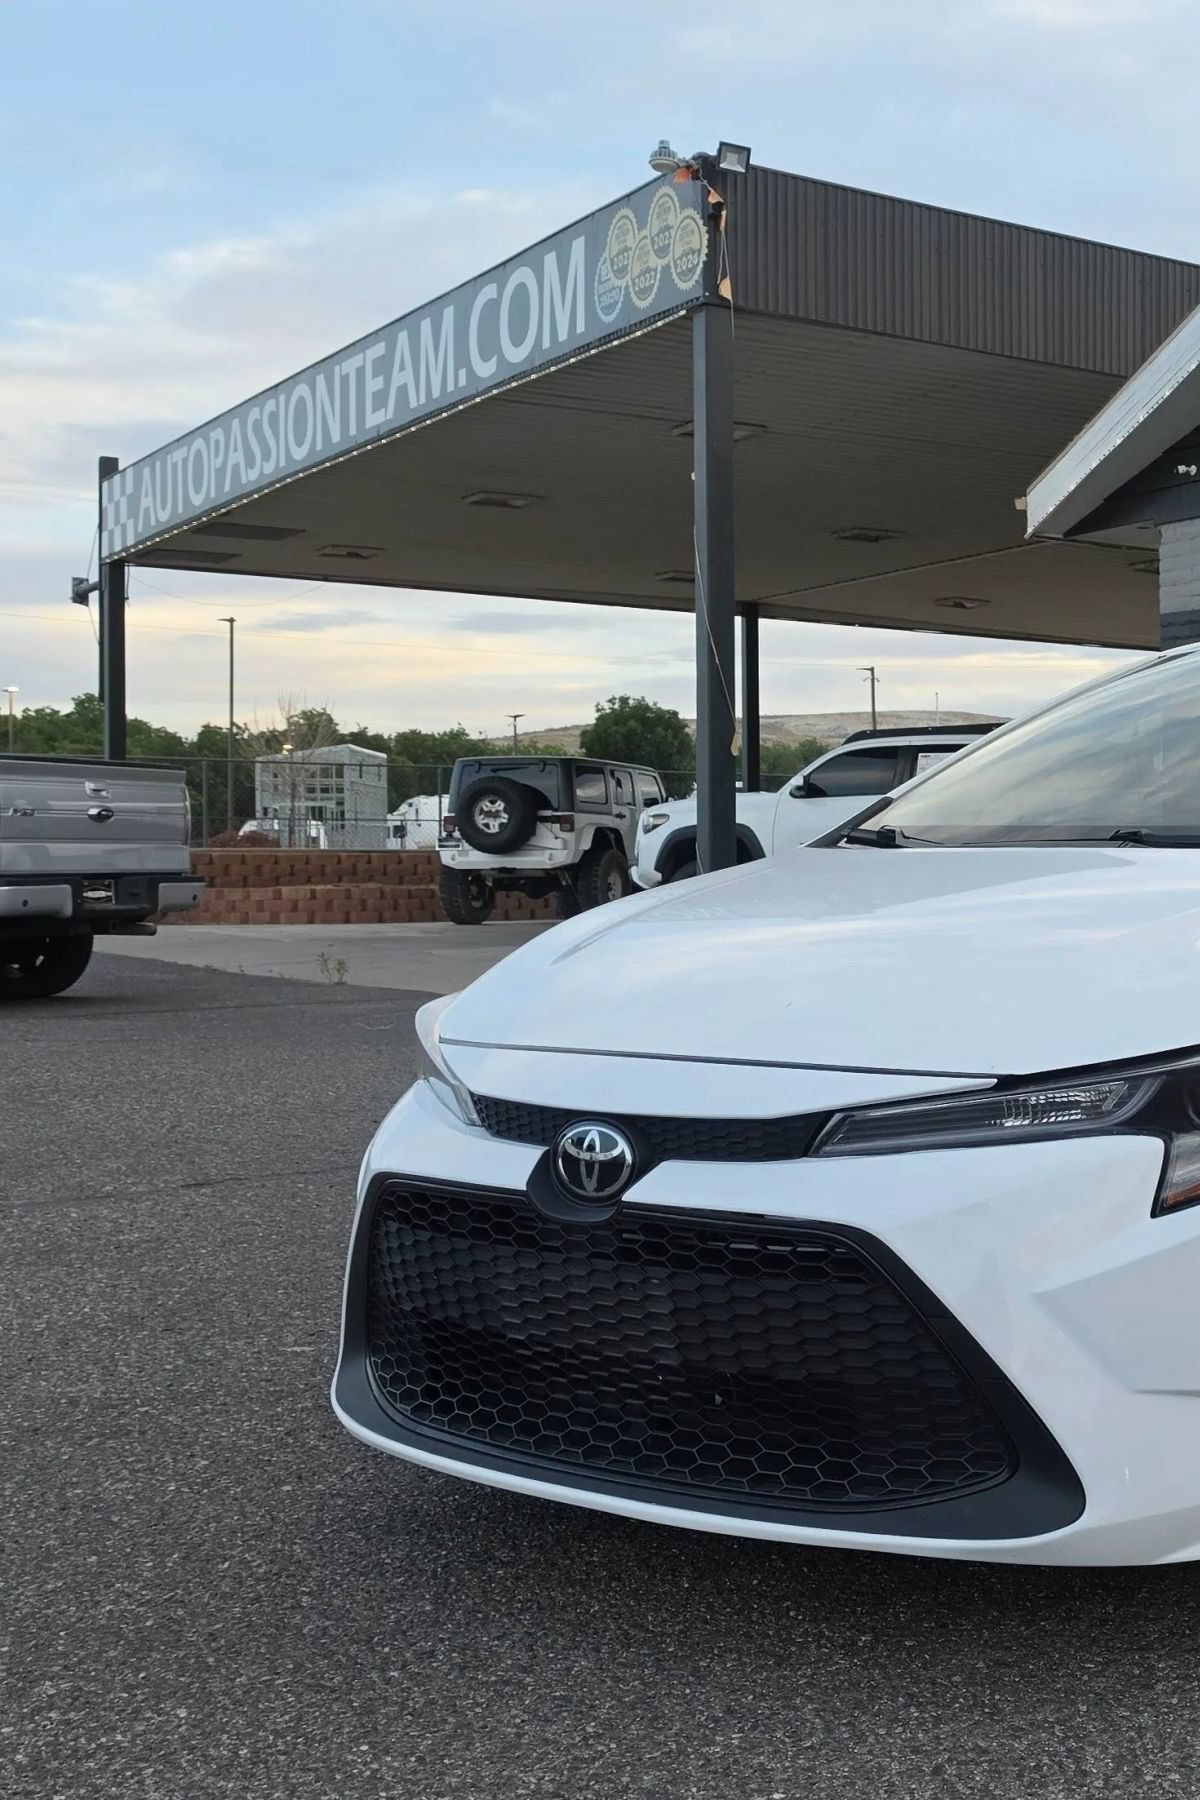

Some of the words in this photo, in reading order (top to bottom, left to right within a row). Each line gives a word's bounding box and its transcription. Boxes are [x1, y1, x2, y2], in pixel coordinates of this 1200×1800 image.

[676, 251, 699, 273] 2024
[634, 270, 655, 291] 2022
[136, 235, 586, 534] AUTOPASSIONTEAM.COM
